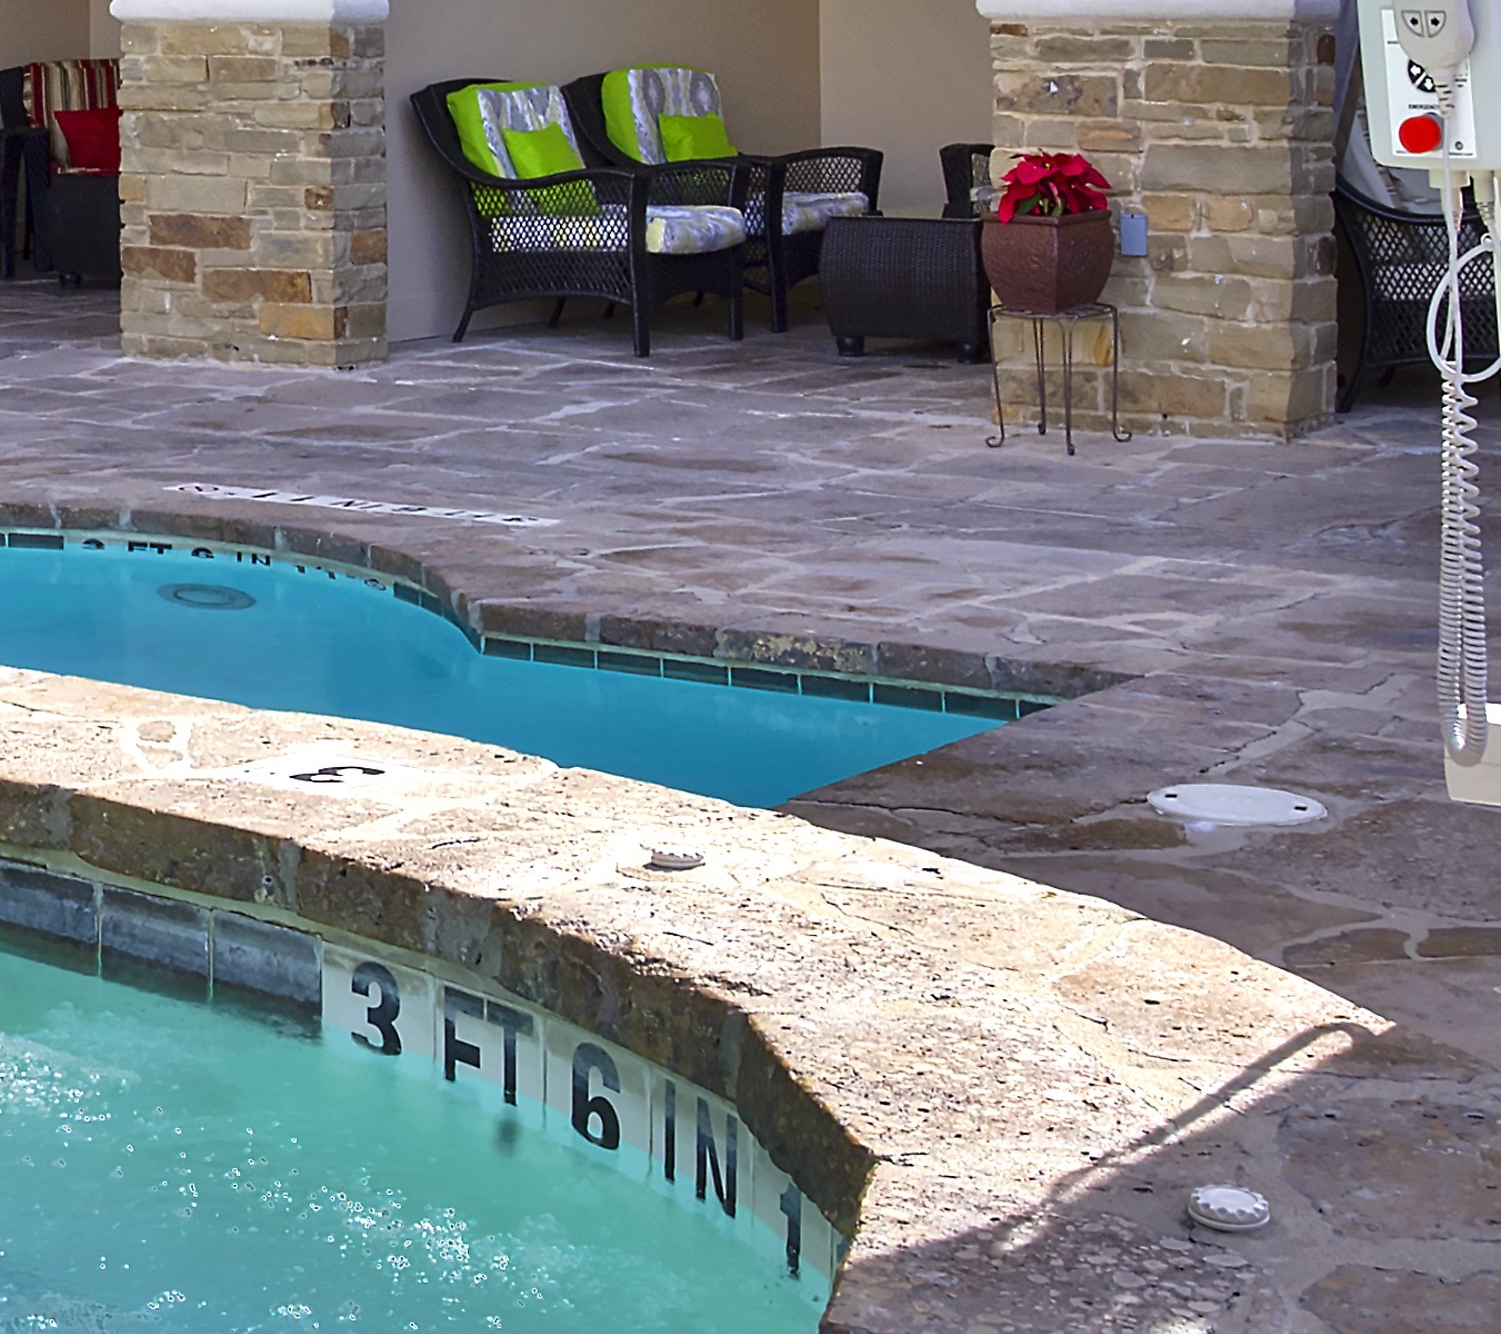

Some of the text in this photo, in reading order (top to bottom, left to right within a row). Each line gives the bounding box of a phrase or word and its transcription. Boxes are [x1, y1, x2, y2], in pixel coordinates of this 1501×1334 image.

[351, 960, 402, 1056] 3
[444, 985, 535, 1107] FT
[570, 1041, 622, 1151] 6
[664, 1078, 739, 1220] IN
